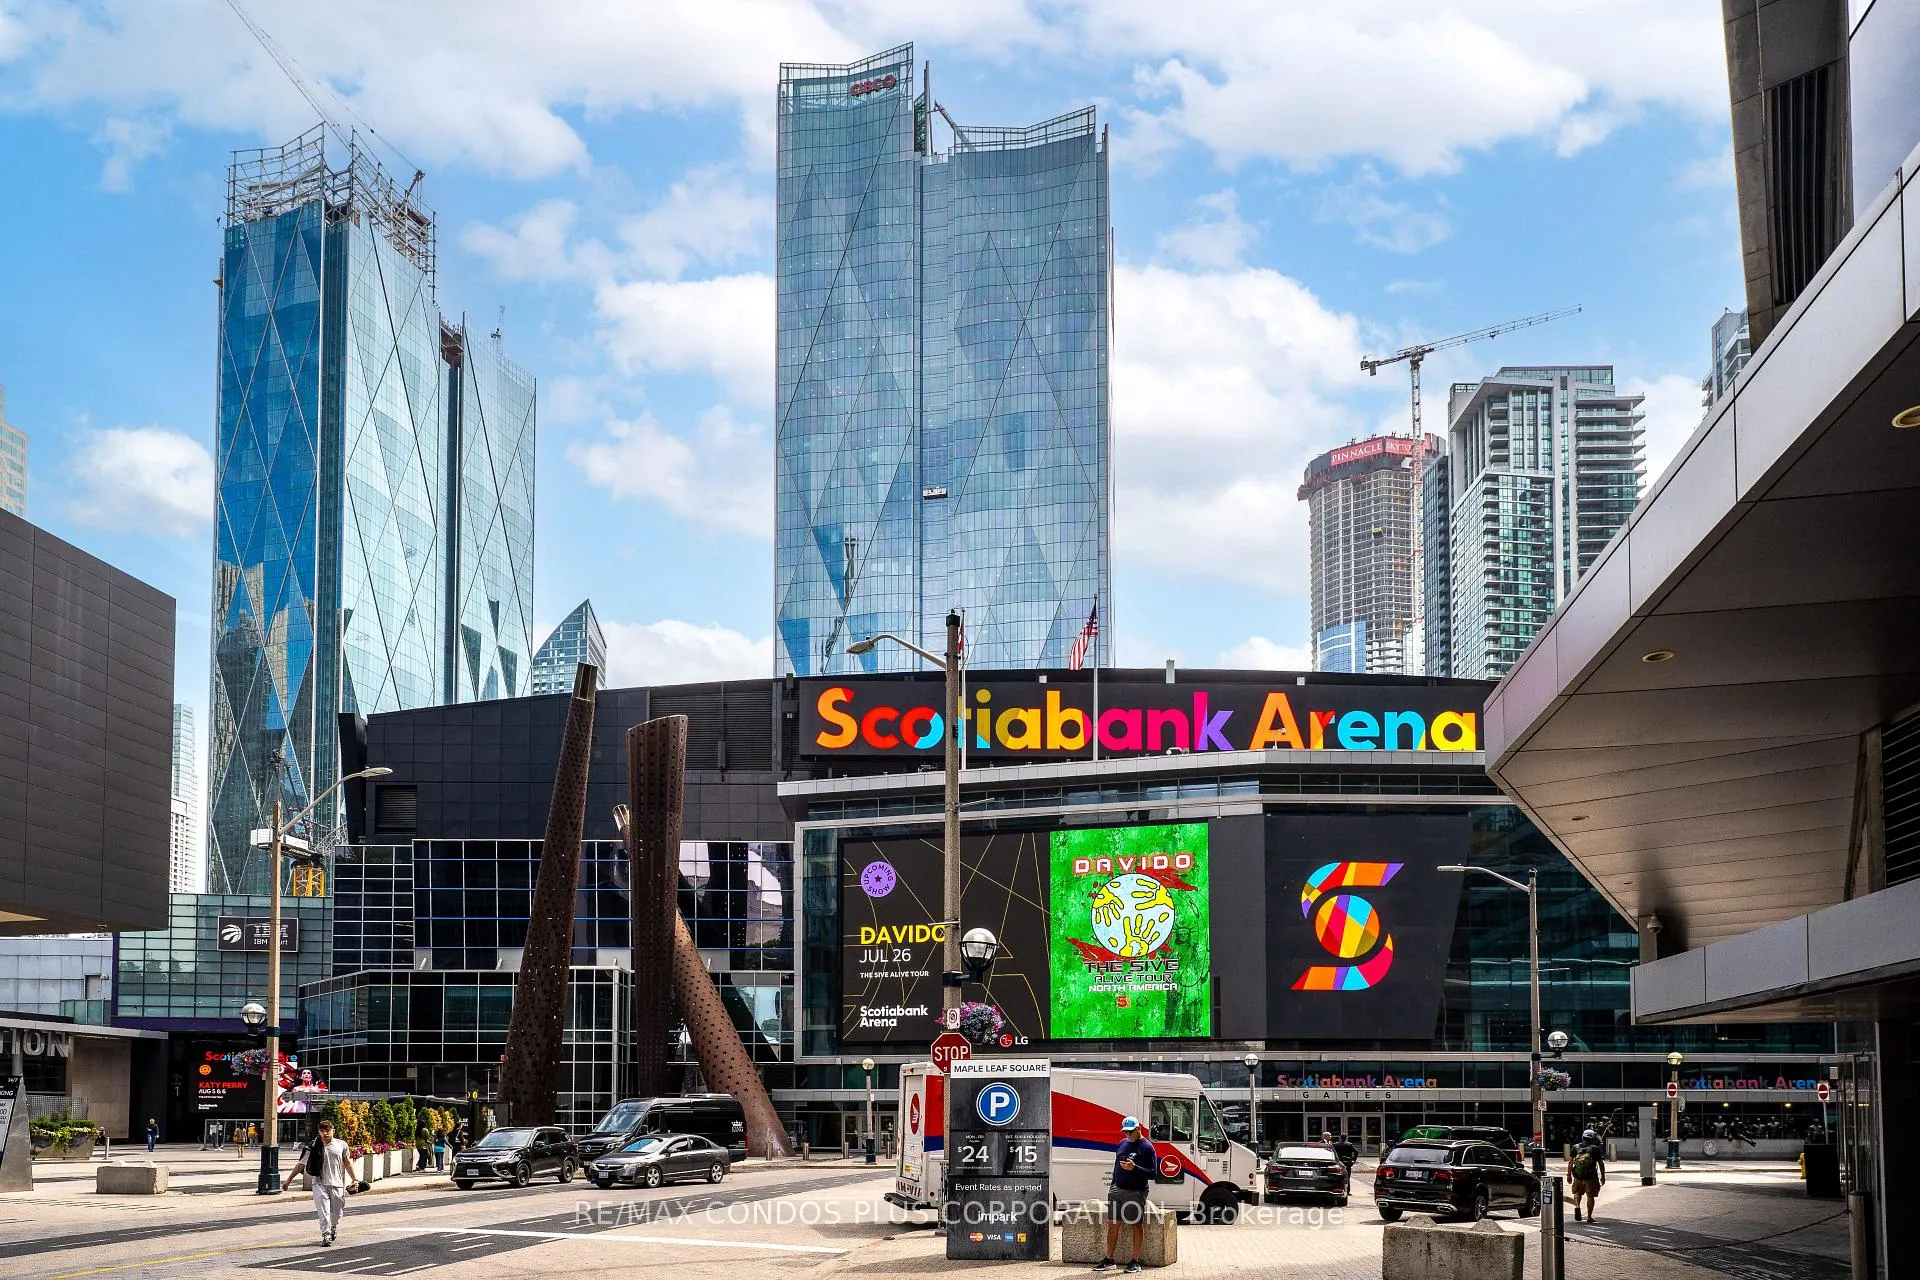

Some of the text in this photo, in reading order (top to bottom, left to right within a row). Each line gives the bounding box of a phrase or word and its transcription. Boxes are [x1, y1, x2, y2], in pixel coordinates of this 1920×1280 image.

[1332, 442, 1382, 463] PINNACLE
[816, 687, 1476, 751] Scotiabank Arena
[1075, 854, 1191, 874] DAVIDO
[864, 864, 893, 885] UPCOMING
[867, 884, 890, 895] SHOW
[859, 948, 911, 963] JUL 26
[1084, 960, 1123, 973] THE
[890, 970, 909, 978] ALIVE
[1094, 973, 1172, 983] ALIVE TOUR
[1089, 983, 1178, 992] NORTH AMERICA
[860, 1005, 928, 1017] Scotiabank
[860, 1017, 897, 1027] Arena
[1014, 1036, 1029, 1045] LG
[934, 1045, 969, 1061] STOP
[954, 1065, 983, 1073] MAPLE
[1010, 1064, 1047, 1072] SQUARE
[199, 1081, 248, 1089] KATY PERRY
[1277, 1073, 1437, 1088] Scotiabank Arena
[1678, 1075, 1817, 1089] cotiabank Aren
[1302, 1091, 1371, 1099] GATE
[990, 1092, 1010, 1117] P
[955, 1183, 978, 1191] Event
[979, 1183, 1001, 1191] Rates
[1014, 1184, 1042, 1192] posted
[977, 1210, 1017, 1224] impark
